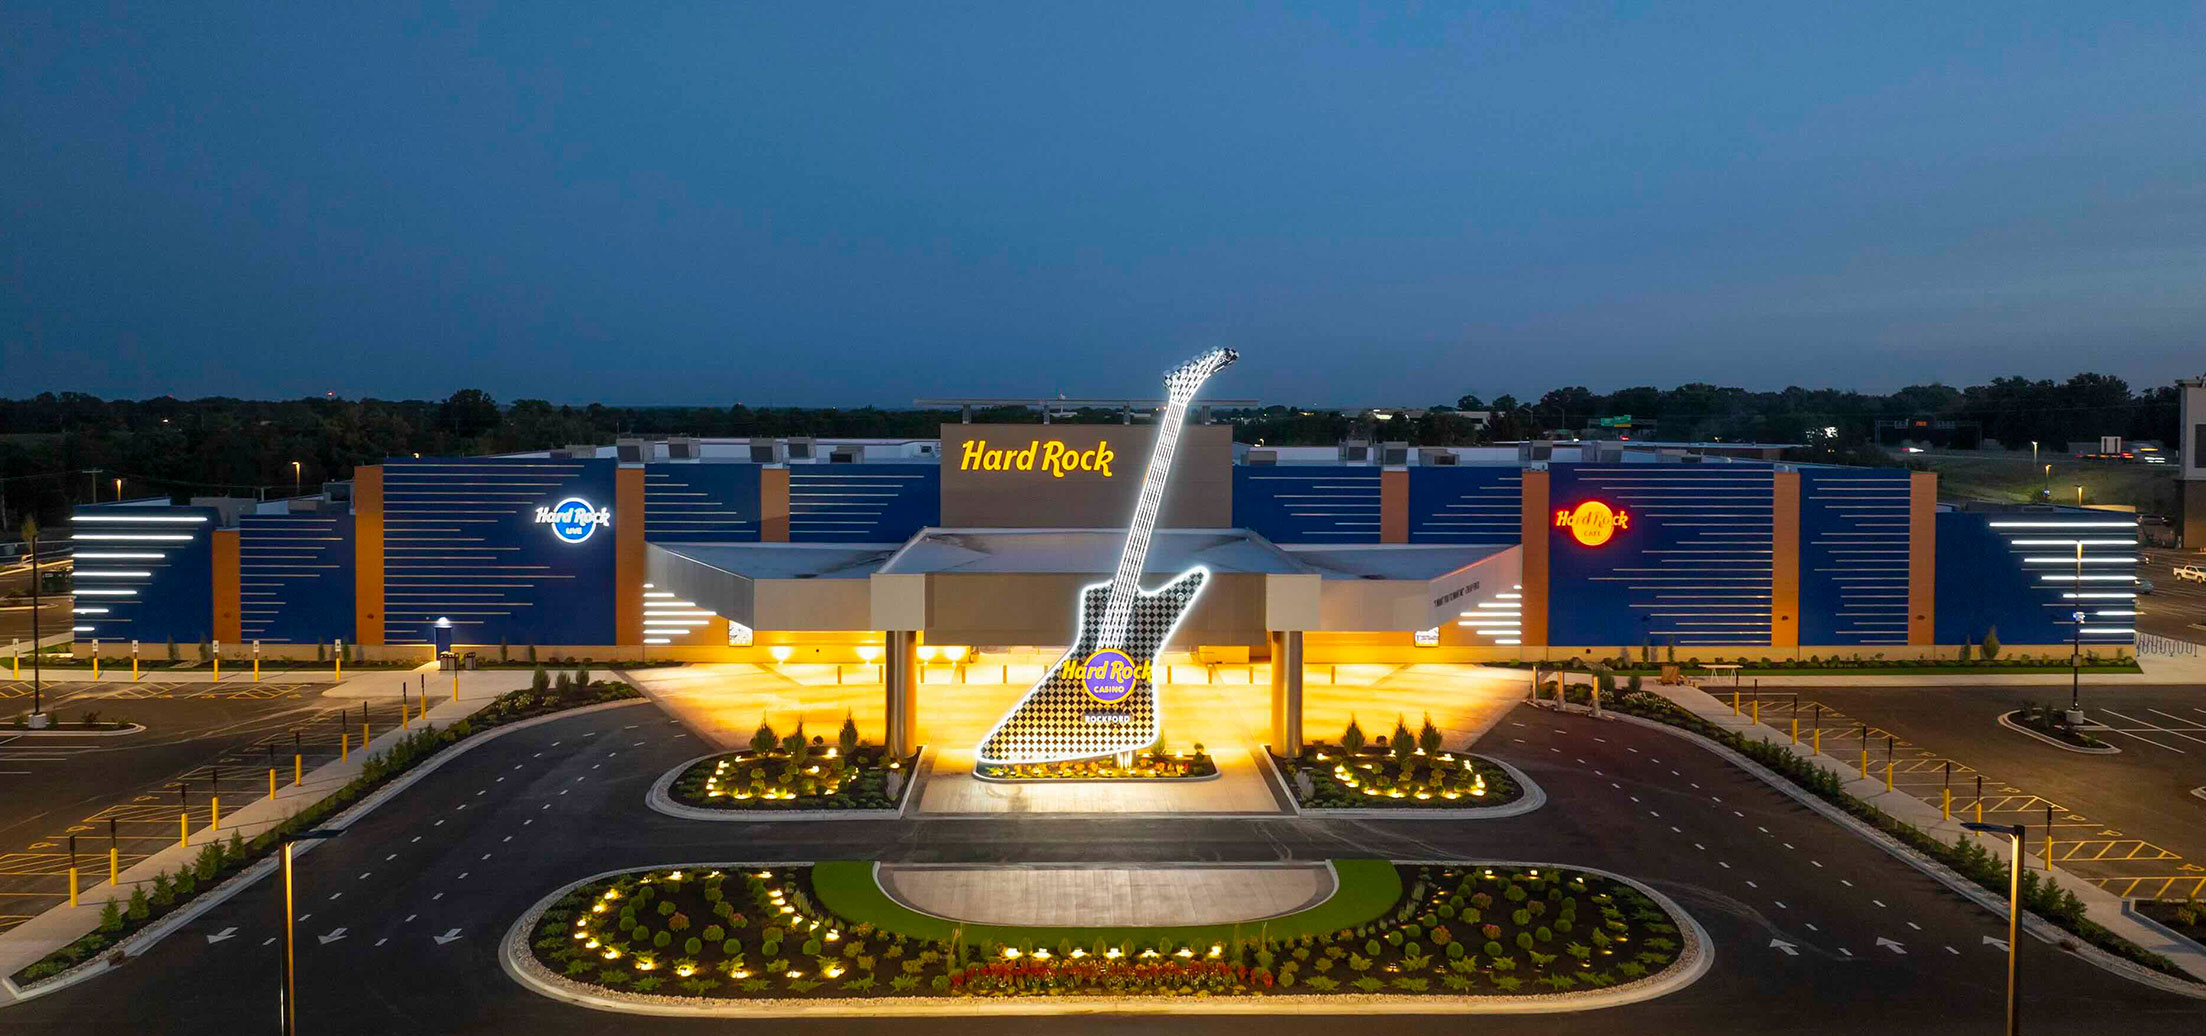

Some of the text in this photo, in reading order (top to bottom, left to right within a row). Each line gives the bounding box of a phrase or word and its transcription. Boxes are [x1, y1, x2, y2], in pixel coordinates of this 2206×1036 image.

[961, 440, 1114, 478] Hard Rock
[535, 506, 610, 526] Hard Rock
[1556, 511, 1628, 529] Hard Rock
[1061, 659, 1152, 683] Hard Rock
[1093, 685, 1125, 694] CASINO
[1084, 715, 1131, 724] ROCKFORD
